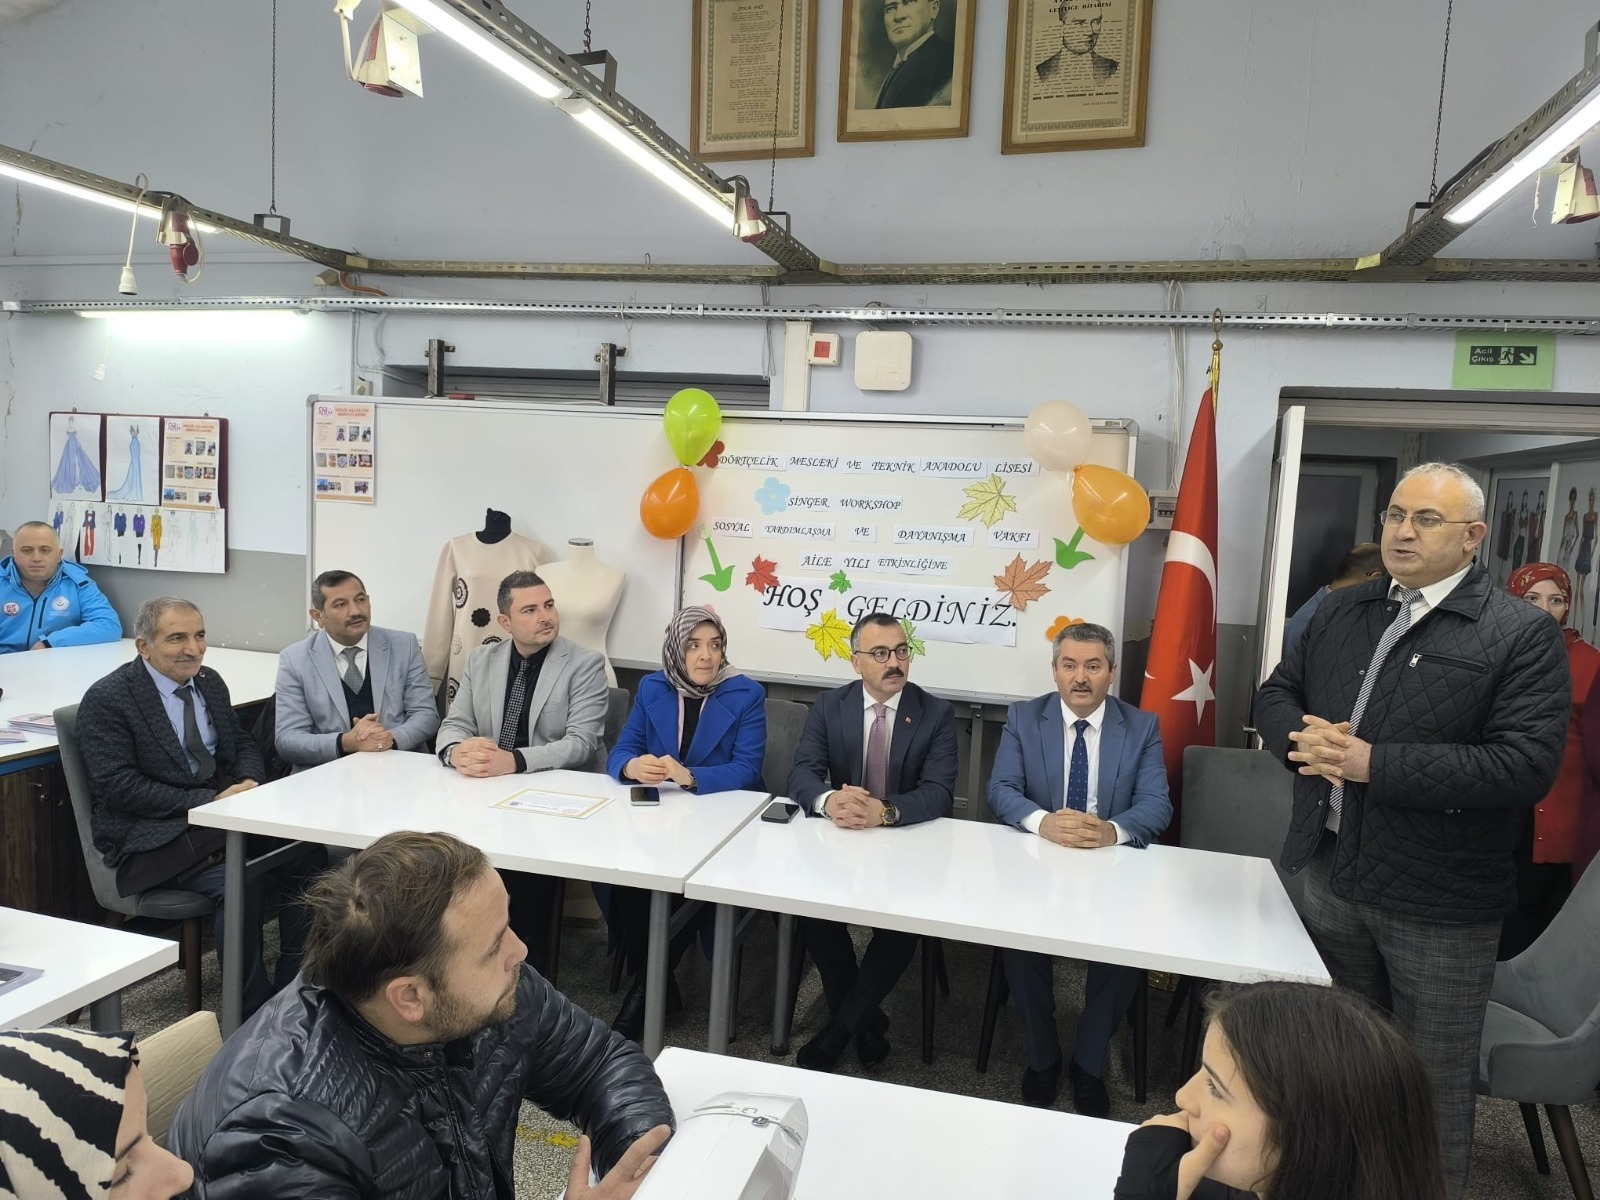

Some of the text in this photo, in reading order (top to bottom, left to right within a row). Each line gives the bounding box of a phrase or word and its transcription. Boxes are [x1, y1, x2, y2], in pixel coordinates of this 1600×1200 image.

[1471, 355, 1494, 363] Çıkış
[718, 455, 1033, 473] DÖRTÇELİK MESLEKİ VE TEKNİK ANADOLU LİSESİ
[787, 496, 902, 510] SİNGER WORKSHOP
[713, 521, 1031, 543] SOSYAL YARDIMLAŞMA VE DAYANIŞMA VAKFI
[801, 554, 948, 571] AİLE YILI ETKİNLİĞİNE
[763, 585, 822, 617] HOŞ
